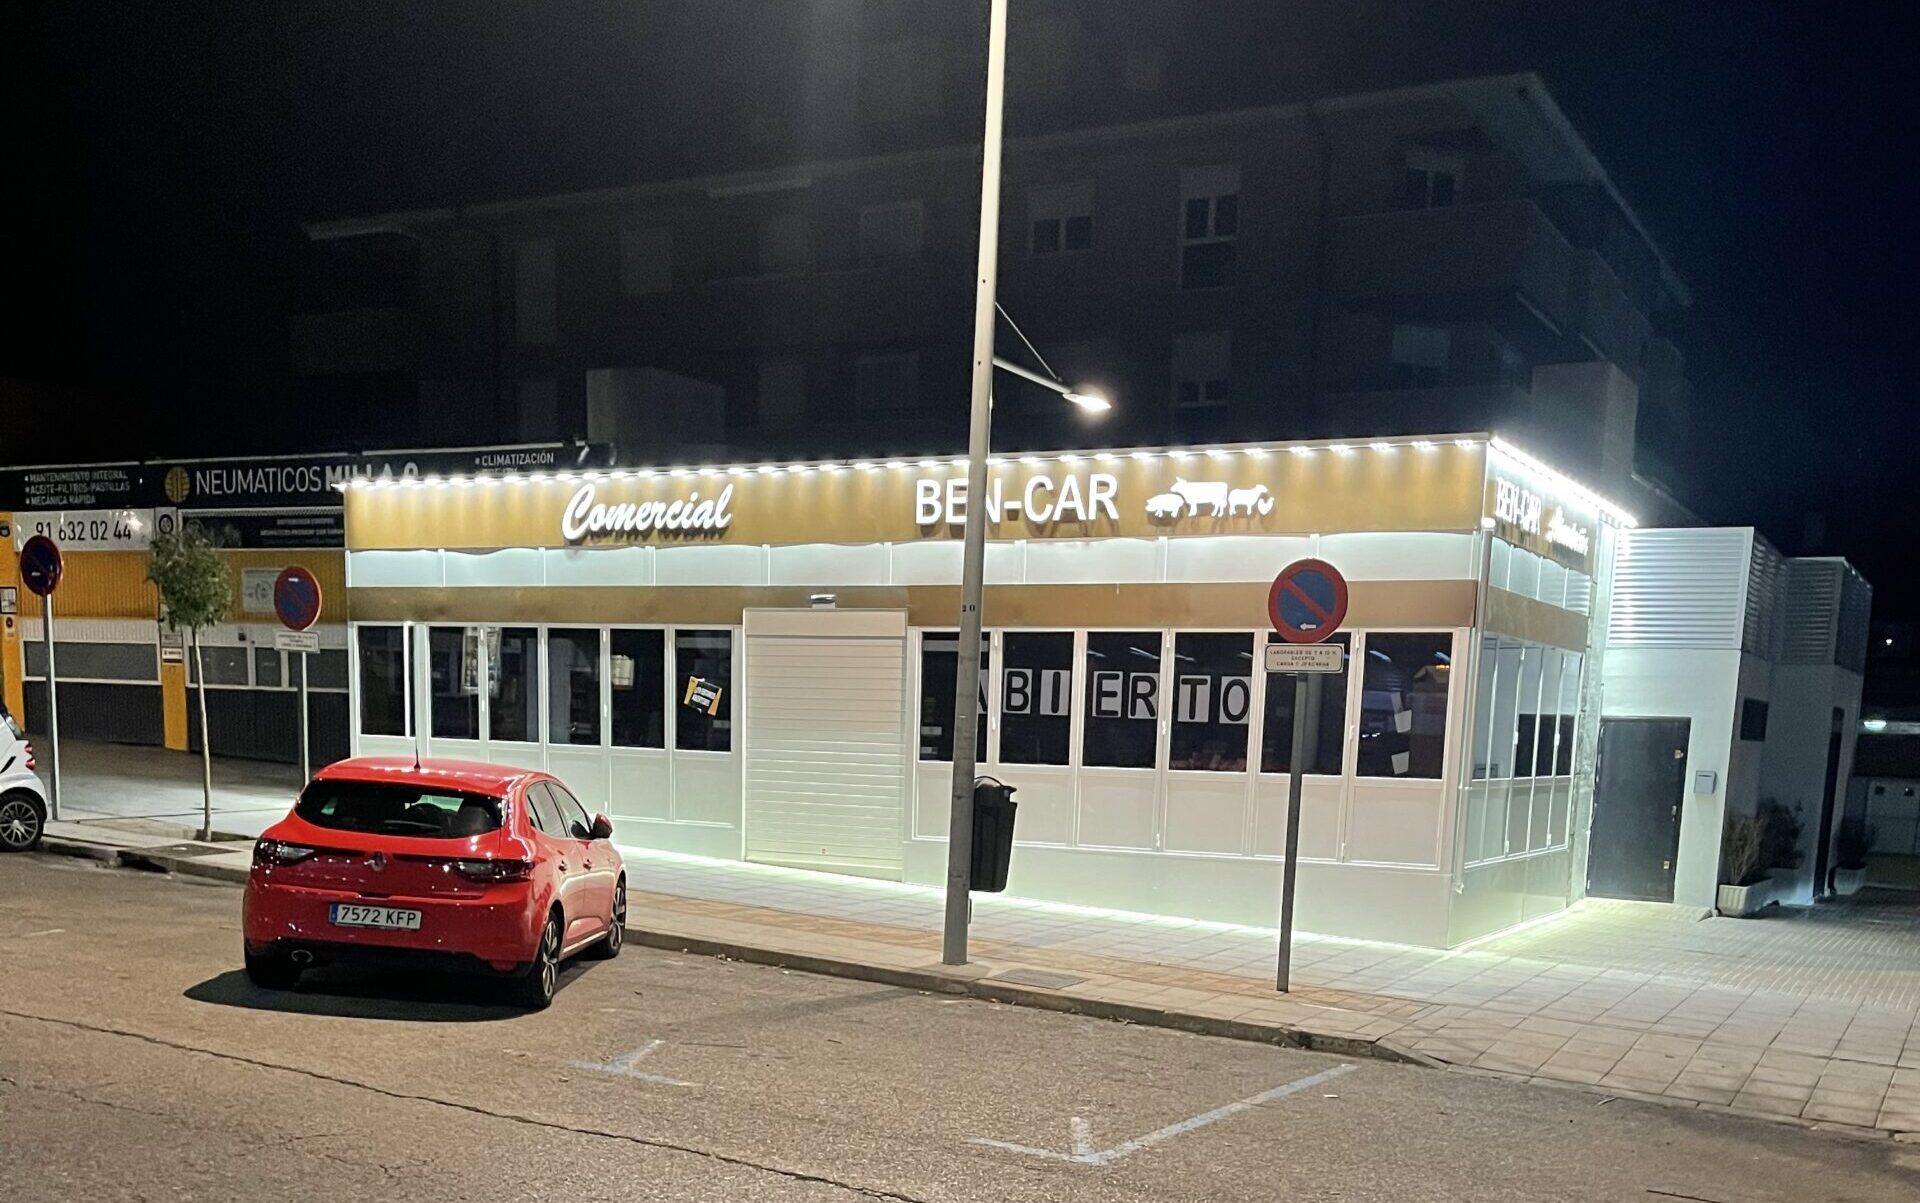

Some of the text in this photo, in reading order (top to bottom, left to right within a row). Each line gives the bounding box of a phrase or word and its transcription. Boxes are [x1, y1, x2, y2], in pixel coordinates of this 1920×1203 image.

[482, 450, 554, 466] CLIMATIZACIÓN
[196, 466, 322, 495] NEUMATICOS
[562, 474, 1119, 540] Comercial BEN-CAR
[36, 520, 132, 541] 91 632 02 44
[341, 906, 416, 926] 7572 KFP
